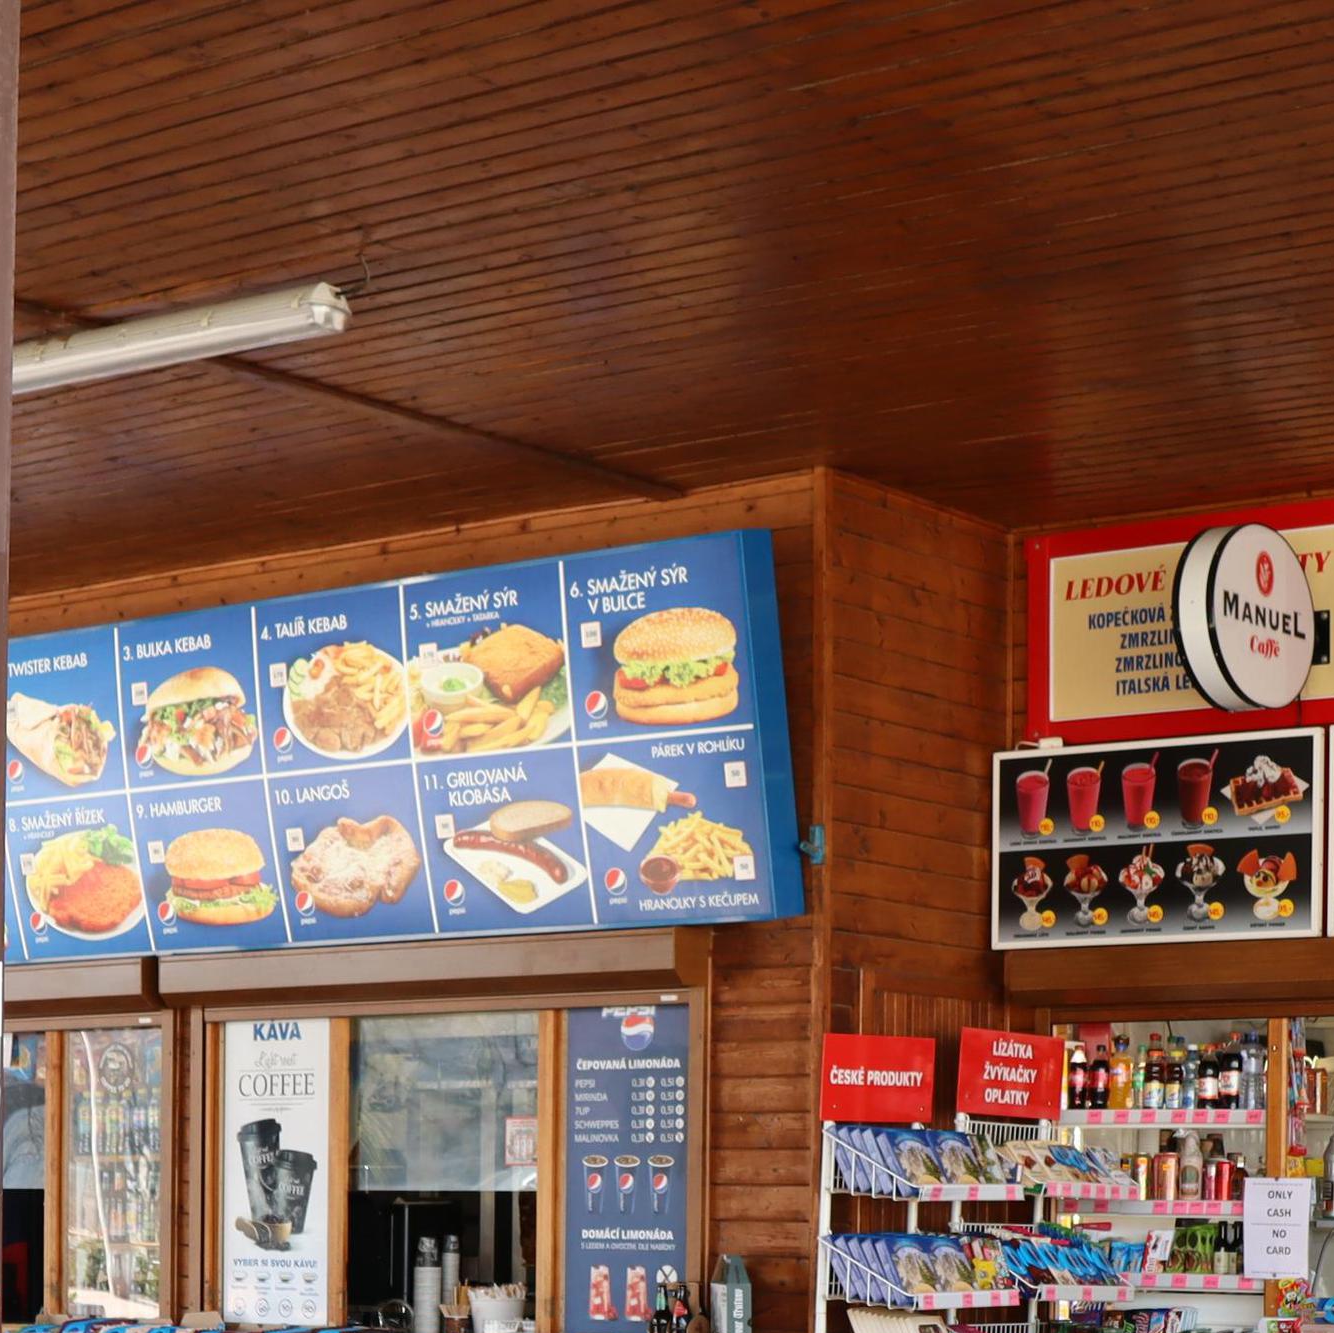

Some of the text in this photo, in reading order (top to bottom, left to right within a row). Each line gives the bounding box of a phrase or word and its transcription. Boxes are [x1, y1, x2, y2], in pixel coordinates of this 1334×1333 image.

[570, 563, 689, 598] 6. SMAŽENÝ SÝR
[1063, 564, 1168, 602] LEDOVÉ
[409, 585, 519, 621] 5. SMAŽENÝ SÝR
[587, 592, 646, 614] V BULCE
[1223, 589, 1307, 640] MANUEL
[260, 613, 348, 642] 4. TALÍŘ KEBAB
[1087, 602, 1166, 631] KOPEČKOVÁ
[123, 633, 212, 661] 3. BULKA KEBAB
[54, 652, 88, 671] KEBAB
[1115, 674, 1171, 697] ITALSKÁ
[651, 738, 745, 759] PÁREK V ROHLÍKU
[424, 761, 527, 791] 11. GRILOVANÁ
[274, 778, 350, 806] 10. LANGOŠ
[448, 786, 512, 807] KLOBÁSA
[136, 796, 222, 819] 9. HAMBURGER
[9, 806, 105, 833] 8. SMAŽENÝ ŘÍZEK
[639, 889, 760, 912] HRANOLKY S KEČUPEM
[992, 1039, 1034, 1059] LÍZÁTKA
[576, 1056, 681, 1071] ČEPOVANÁ LIMONÁDA
[983, 1061, 1038, 1084] ŽVÝKAČKY
[238, 1072, 315, 1098] COFFEE
[830, 1064, 923, 1088] ČESKÉ PRODUKTY
[984, 1088, 1030, 1107] OPLATKY
[1267, 1189, 1293, 1200] ONLY
[1267, 1207, 1292, 1218] CASH
[581, 1227, 674, 1240] DOMÁCÍ LIMONÁDA
[1272, 1229, 1287, 1239] NO
[1266, 1245, 1292, 1256] CARD
